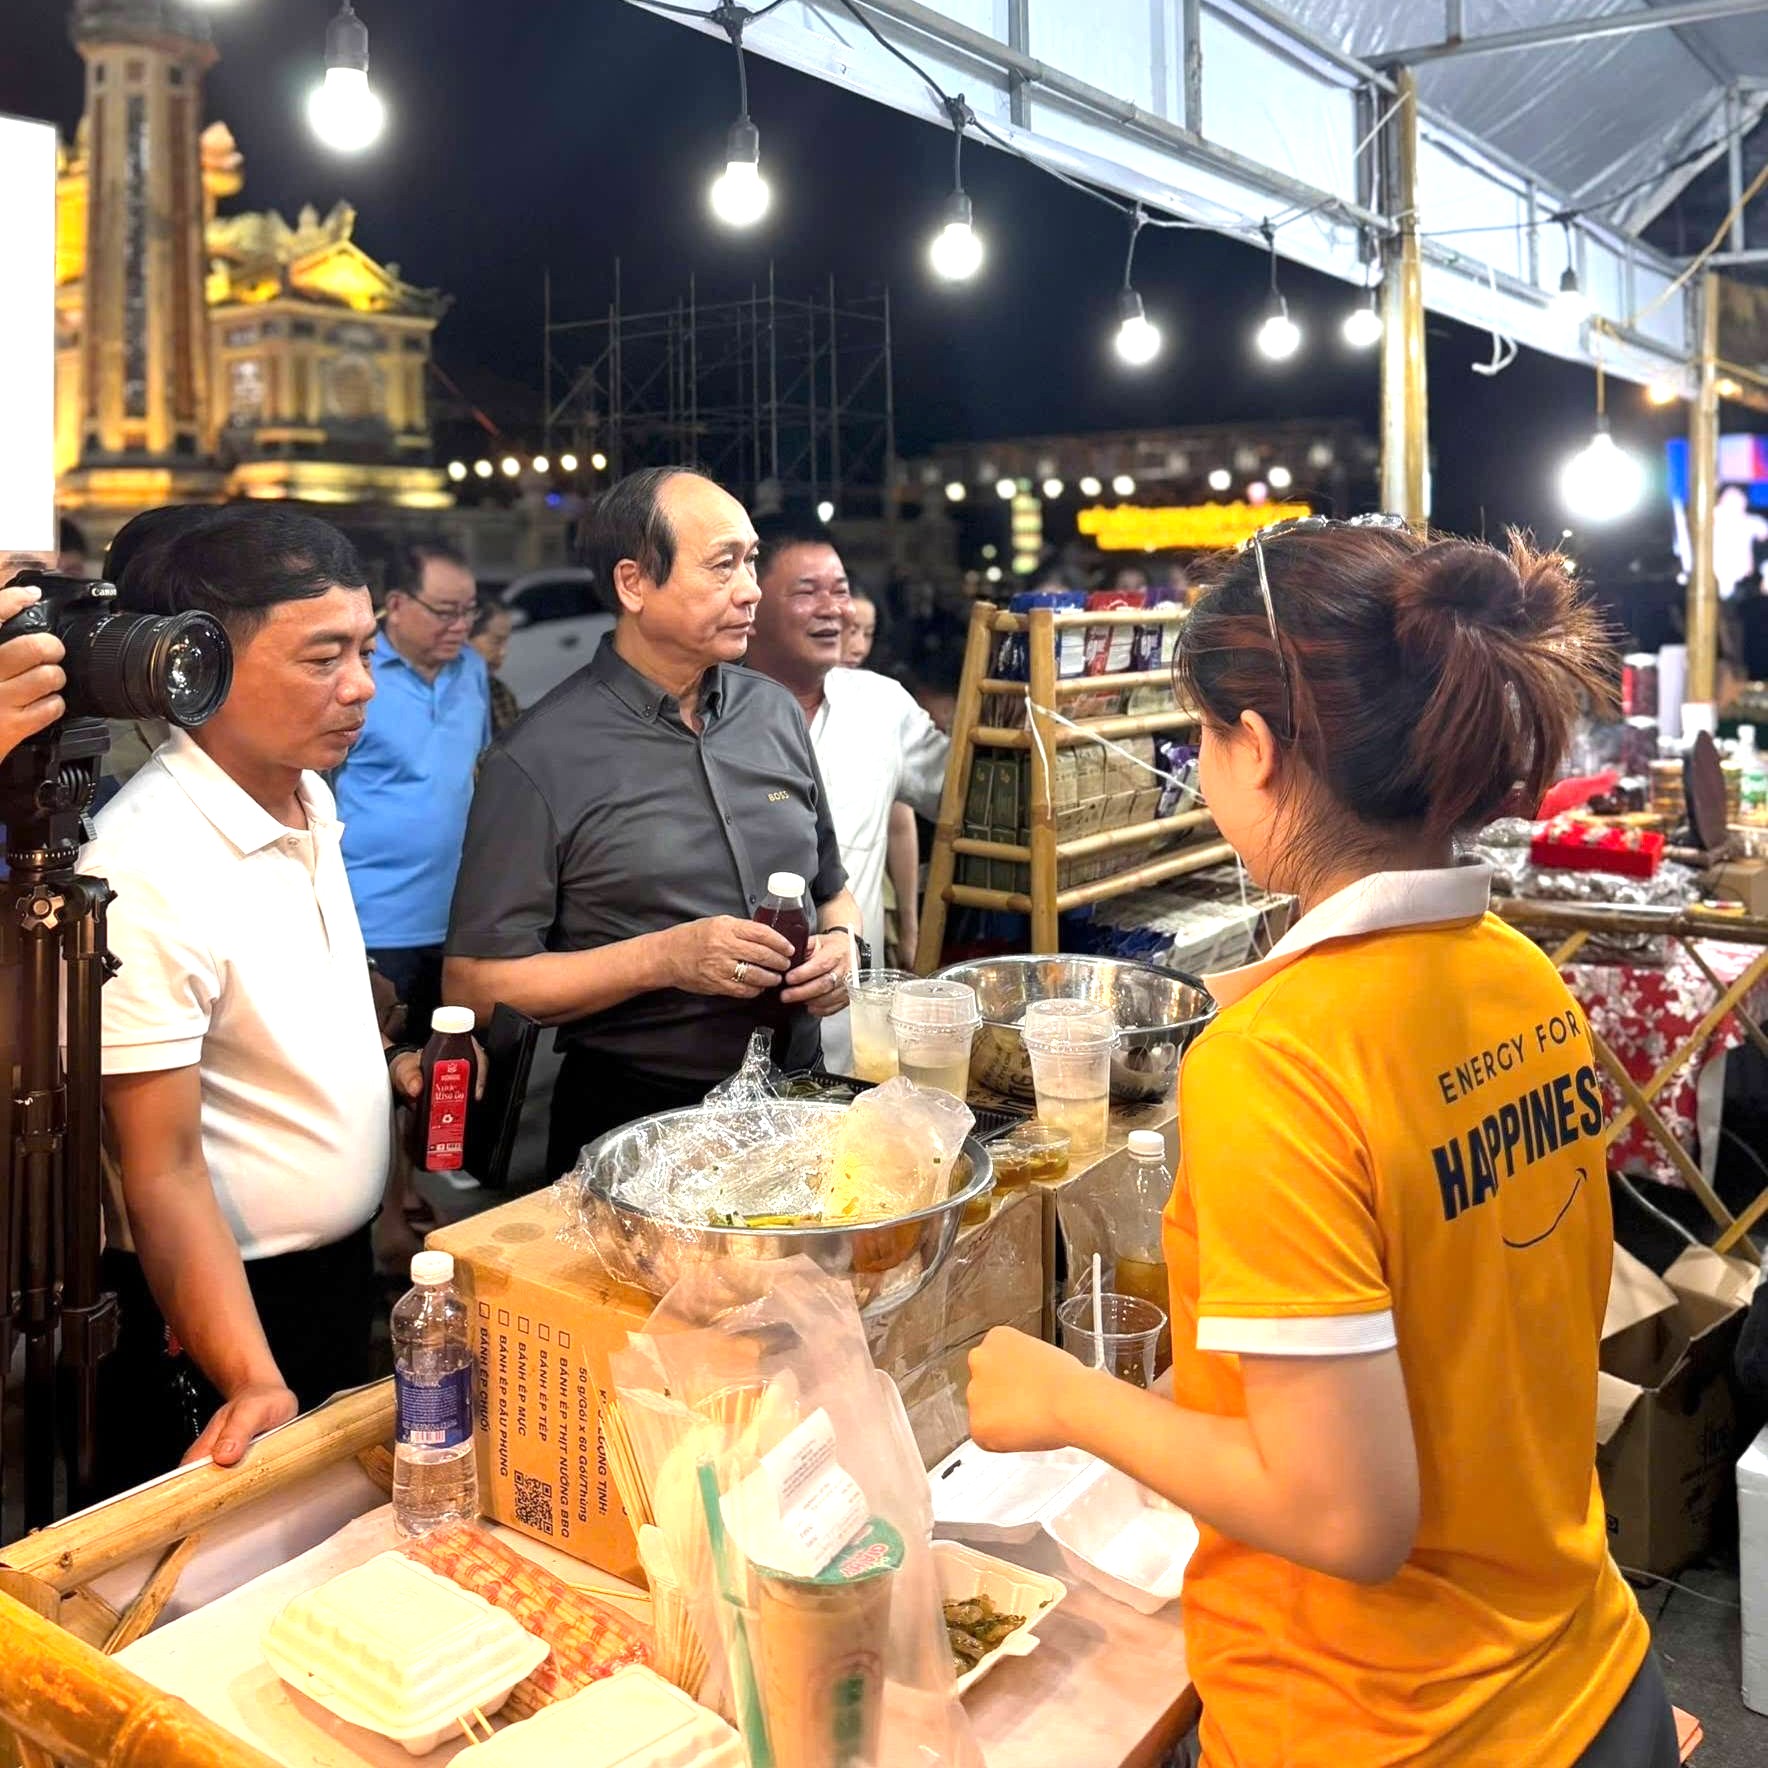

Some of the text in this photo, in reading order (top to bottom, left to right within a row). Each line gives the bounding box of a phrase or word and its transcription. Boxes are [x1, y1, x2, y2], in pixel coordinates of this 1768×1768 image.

[768, 790, 790, 802] BOSS
[1438, 1009, 1582, 1105] ENERGY FOR
[1432, 1065, 1602, 1222] HAPPINES
[499, 1335, 508, 1373] BÁNH
[479, 1327, 491, 1432] BÁNH ÉP CHUỐI
[499, 1377, 508, 1396] ÉP
[518, 1342, 527, 1436] BÁNH ÉP MỰC
[579, 1367, 587, 1383] 50
[538, 1350, 548, 1441] BÁNH ÉP TÉP
[577, 1385, 588, 1421] g/Gói
[578, 1436, 587, 1452] 60
[579, 1424, 586, 1432] x
[499, 1430, 508, 1476] PHỤNG
[558, 1357, 570, 1538] BÁNH ÉP THỊT NƯỚNG BBQ
[597, 1480, 608, 1516] TỊNH:
